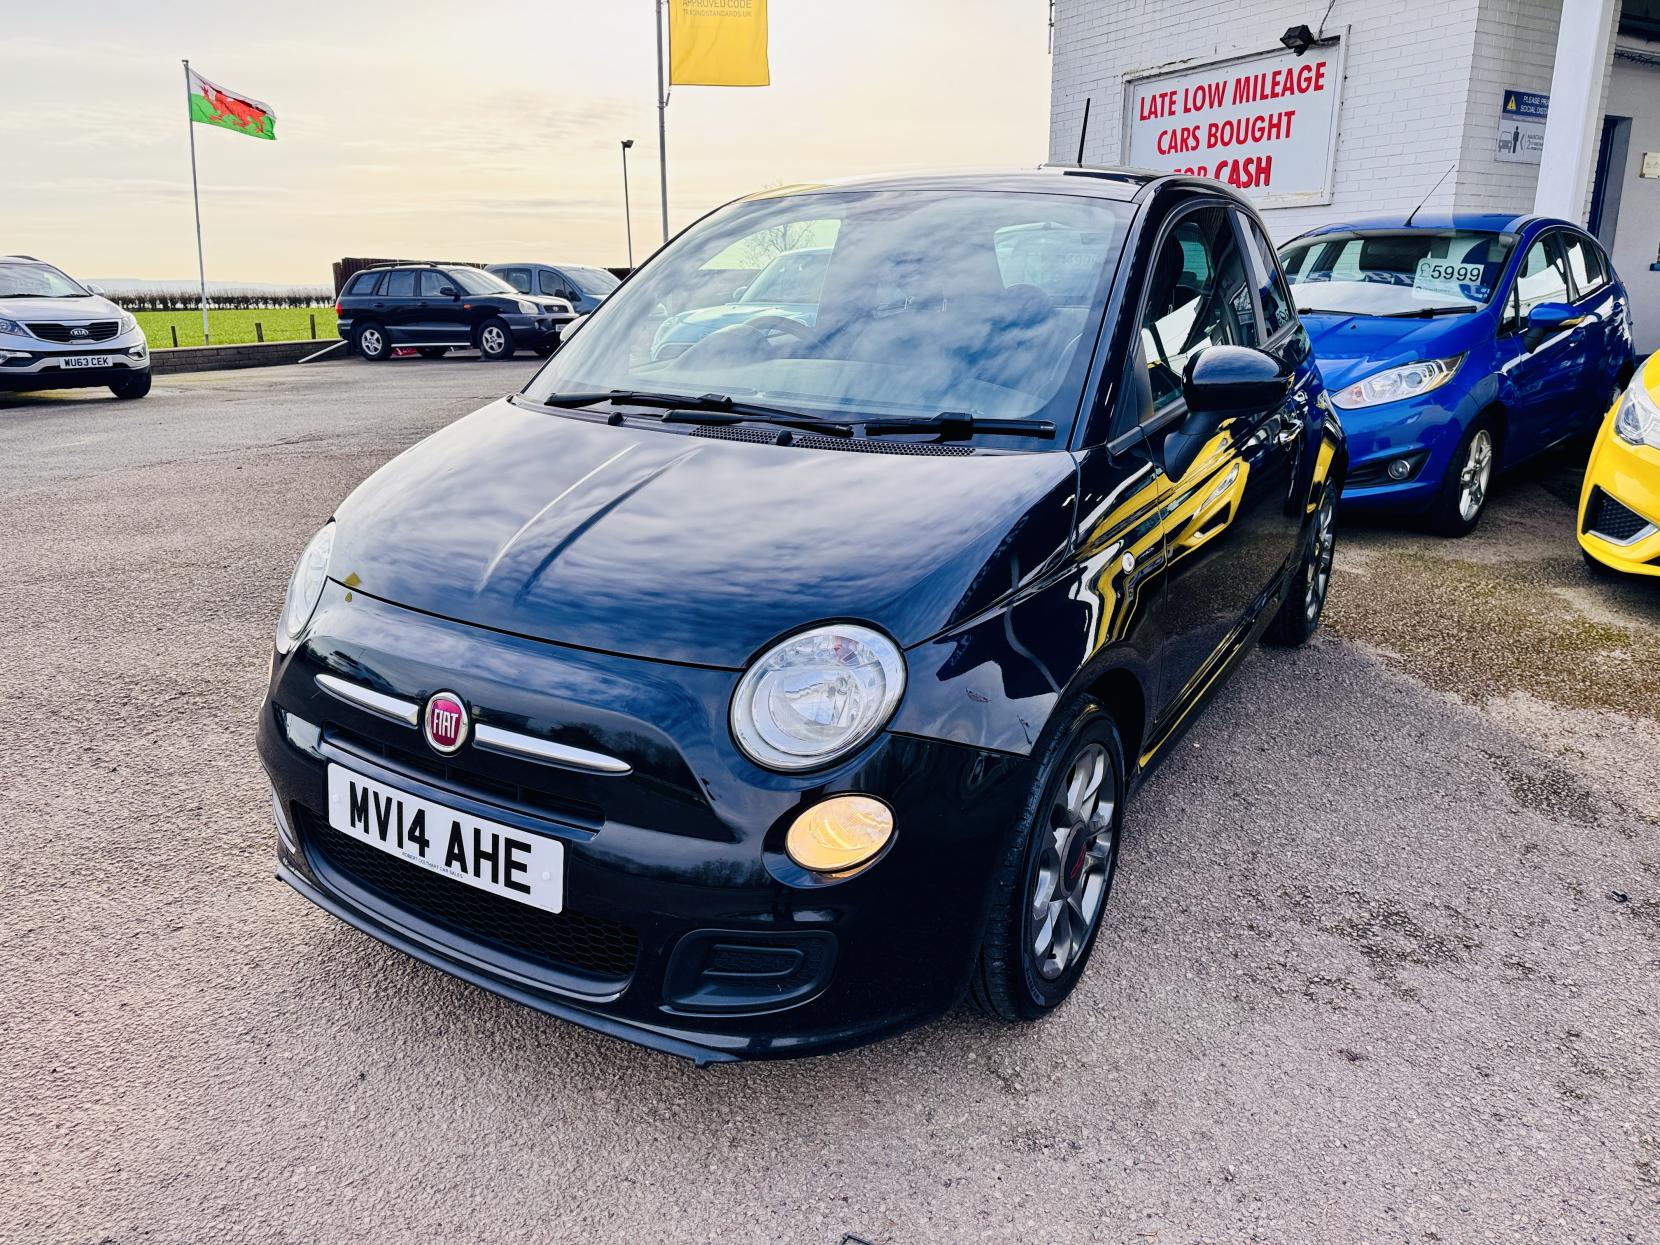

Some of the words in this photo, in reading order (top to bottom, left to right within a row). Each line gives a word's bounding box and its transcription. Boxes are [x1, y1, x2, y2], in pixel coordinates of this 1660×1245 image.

[727, 0, 752, 8] CODE
[1139, 91, 1177, 121] LATE
[1183, 81, 1227, 113] LOW
[1232, 62, 1327, 105] MILEAGE
[1523, 96, 1540, 104] PLEASE
[1520, 105, 1536, 113] SOCIAL
[1157, 125, 1200, 155] CARS
[1207, 110, 1296, 149] BOUGHT
[1215, 155, 1272, 188] CASH
[1420, 262, 1481, 282] £5999
[73, 328, 87, 336] KIA
[64, 358, 89, 367] WU63
[91, 357, 109, 366] CEK
[433, 708, 459, 739] FIAT
[349, 781, 430, 858] MV14
[444, 820, 532, 895] AHE
[440, 866, 449, 874] CAR
[449, 868, 464, 879] SALES
